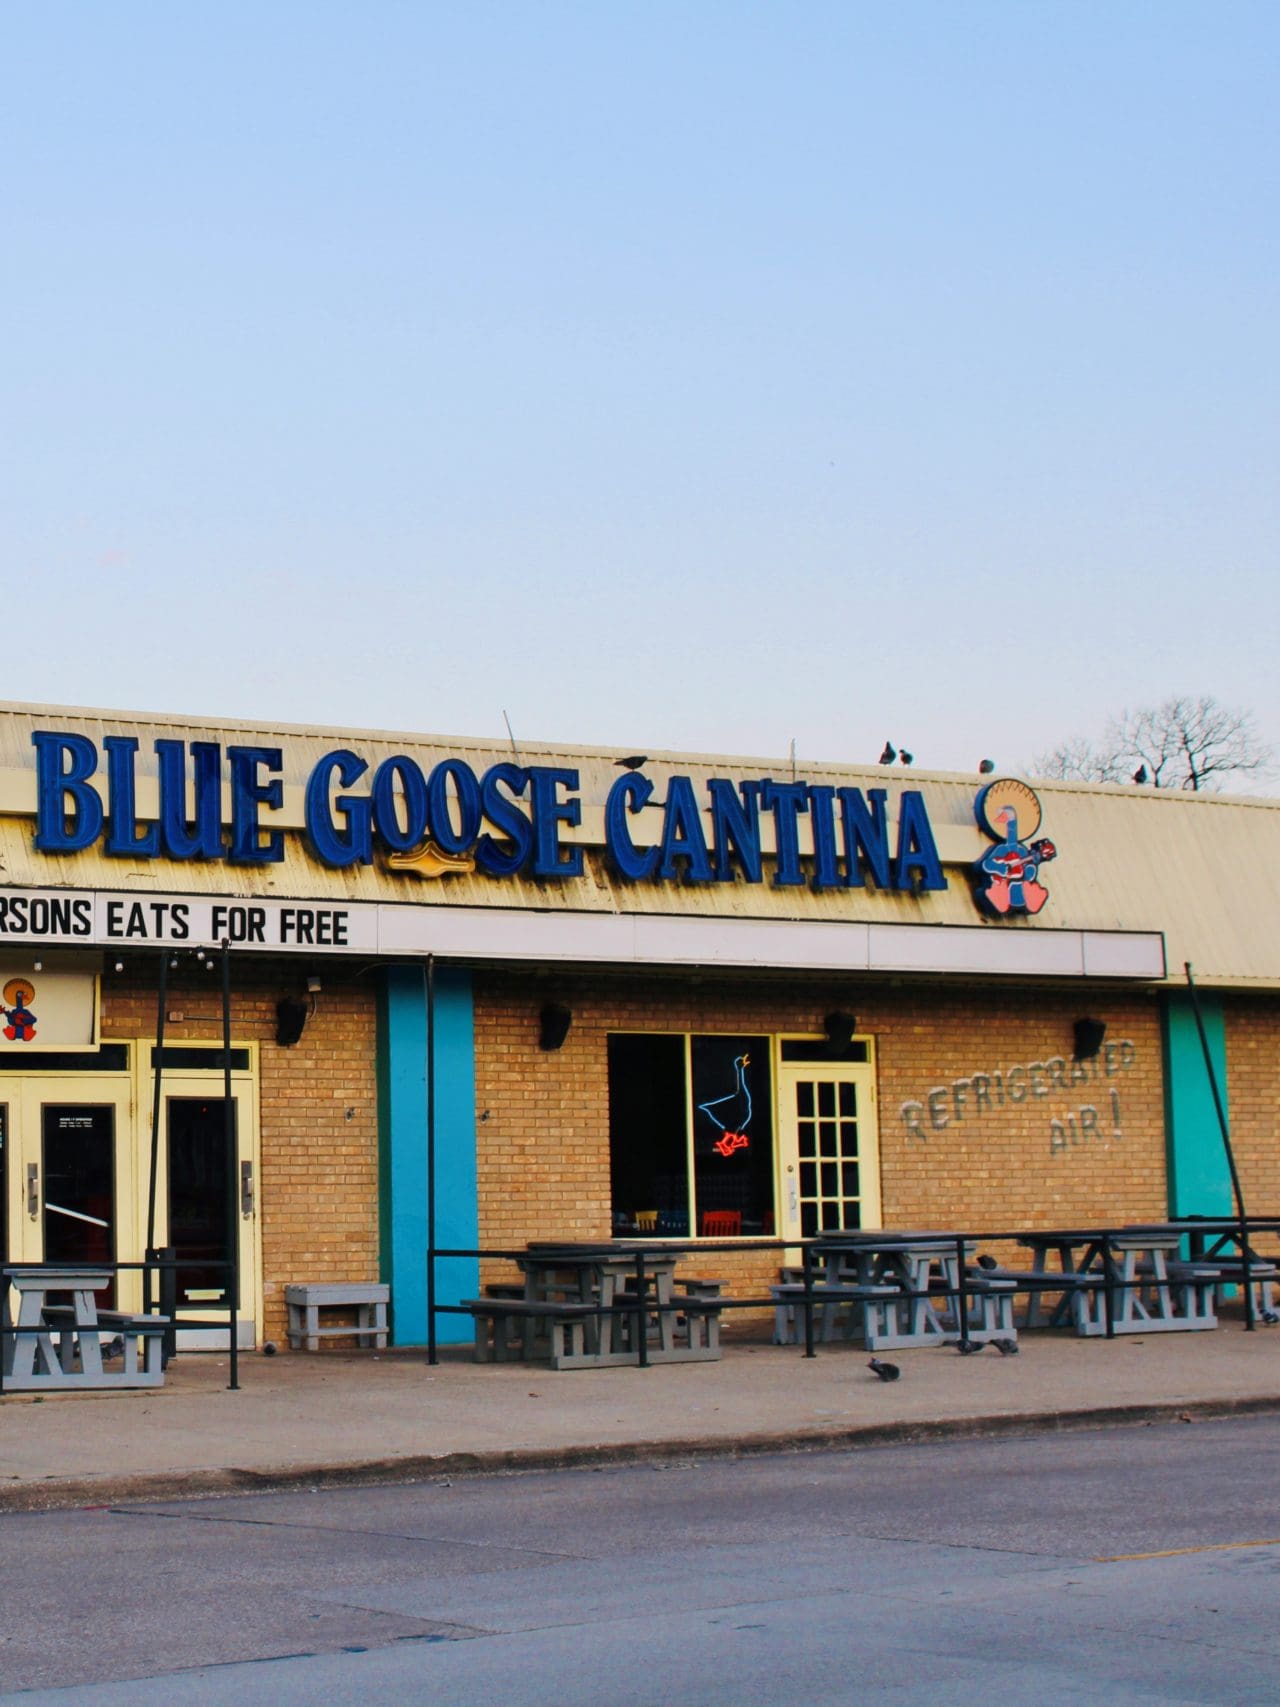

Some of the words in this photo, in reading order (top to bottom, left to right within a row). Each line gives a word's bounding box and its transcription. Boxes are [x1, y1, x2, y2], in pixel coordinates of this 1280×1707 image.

[31, 730, 285, 862] BLUE
[305, 749, 583, 876] GOOSE
[607, 772, 948, 890] CANTINA
[106, 901, 189, 939] EATS
[211, 906, 266, 942] FOR
[280, 908, 349, 945] FREE
